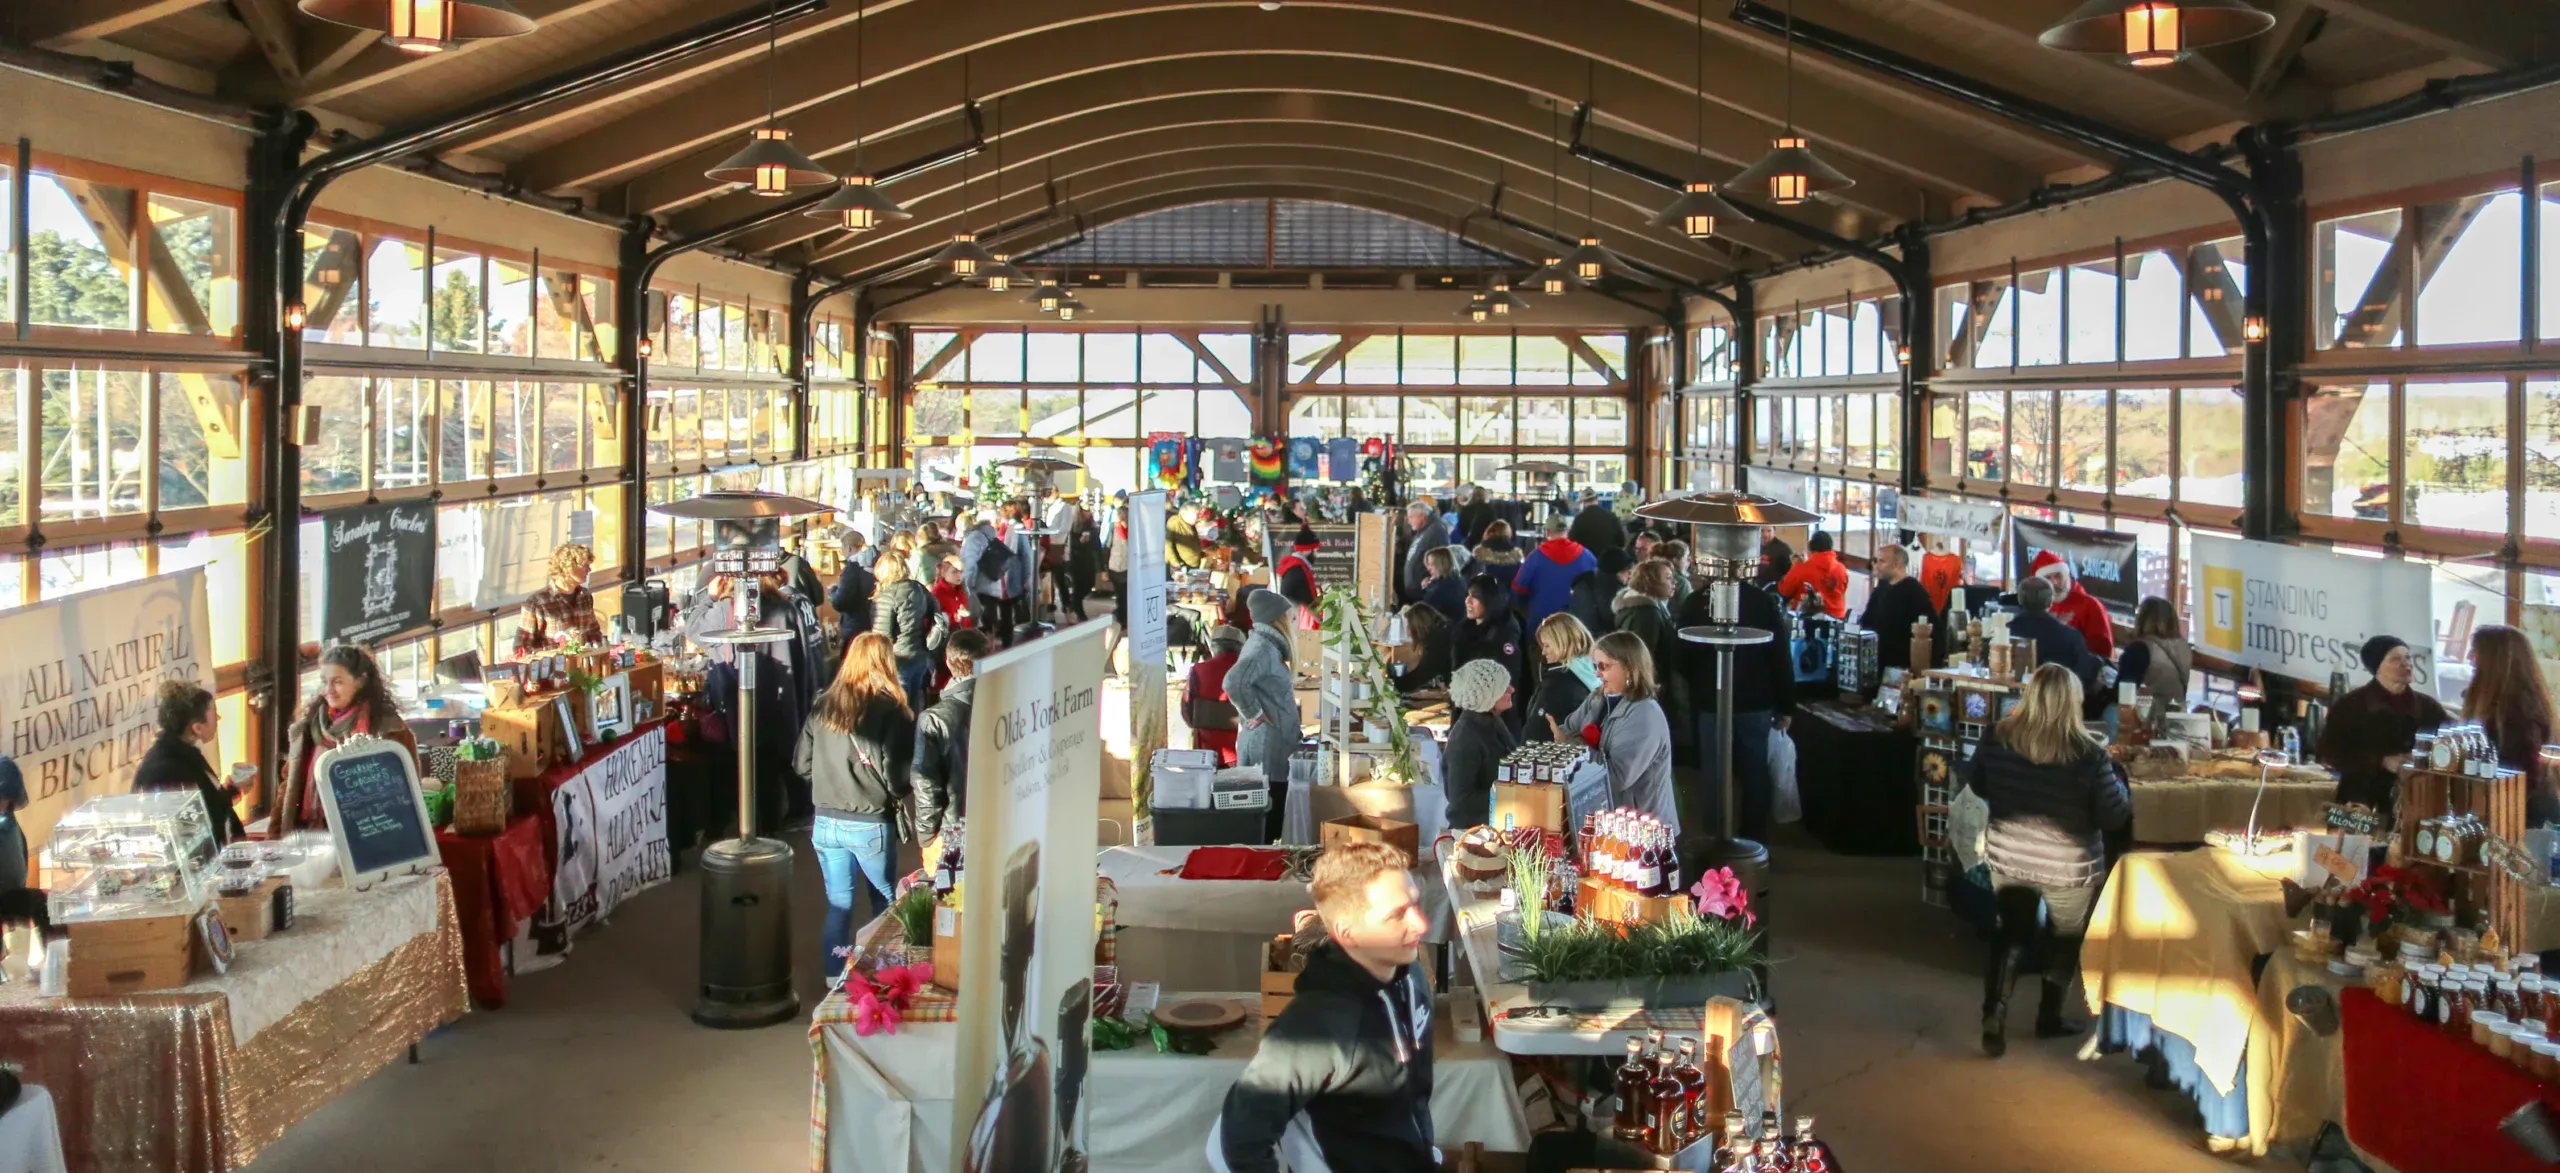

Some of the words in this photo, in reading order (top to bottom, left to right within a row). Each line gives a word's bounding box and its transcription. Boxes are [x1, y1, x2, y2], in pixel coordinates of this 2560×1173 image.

[2081, 556, 2121, 582] SANGRIA
[2245, 578, 2328, 620] STANDING
[20, 659, 73, 710] ALL
[77, 625, 189, 692] NATURAL
[2247, 612, 2428, 685] impresss
[11, 676, 152, 760] HOMEMADE
[993, 707, 1026, 753] Olde
[1030, 698, 1061, 734] York
[1062, 684, 1094, 718] Farm
[604, 726, 667, 801] HOMEMADE
[605, 811, 627, 865] ALL
[2328, 814, 2370, 833] ALLOWED
